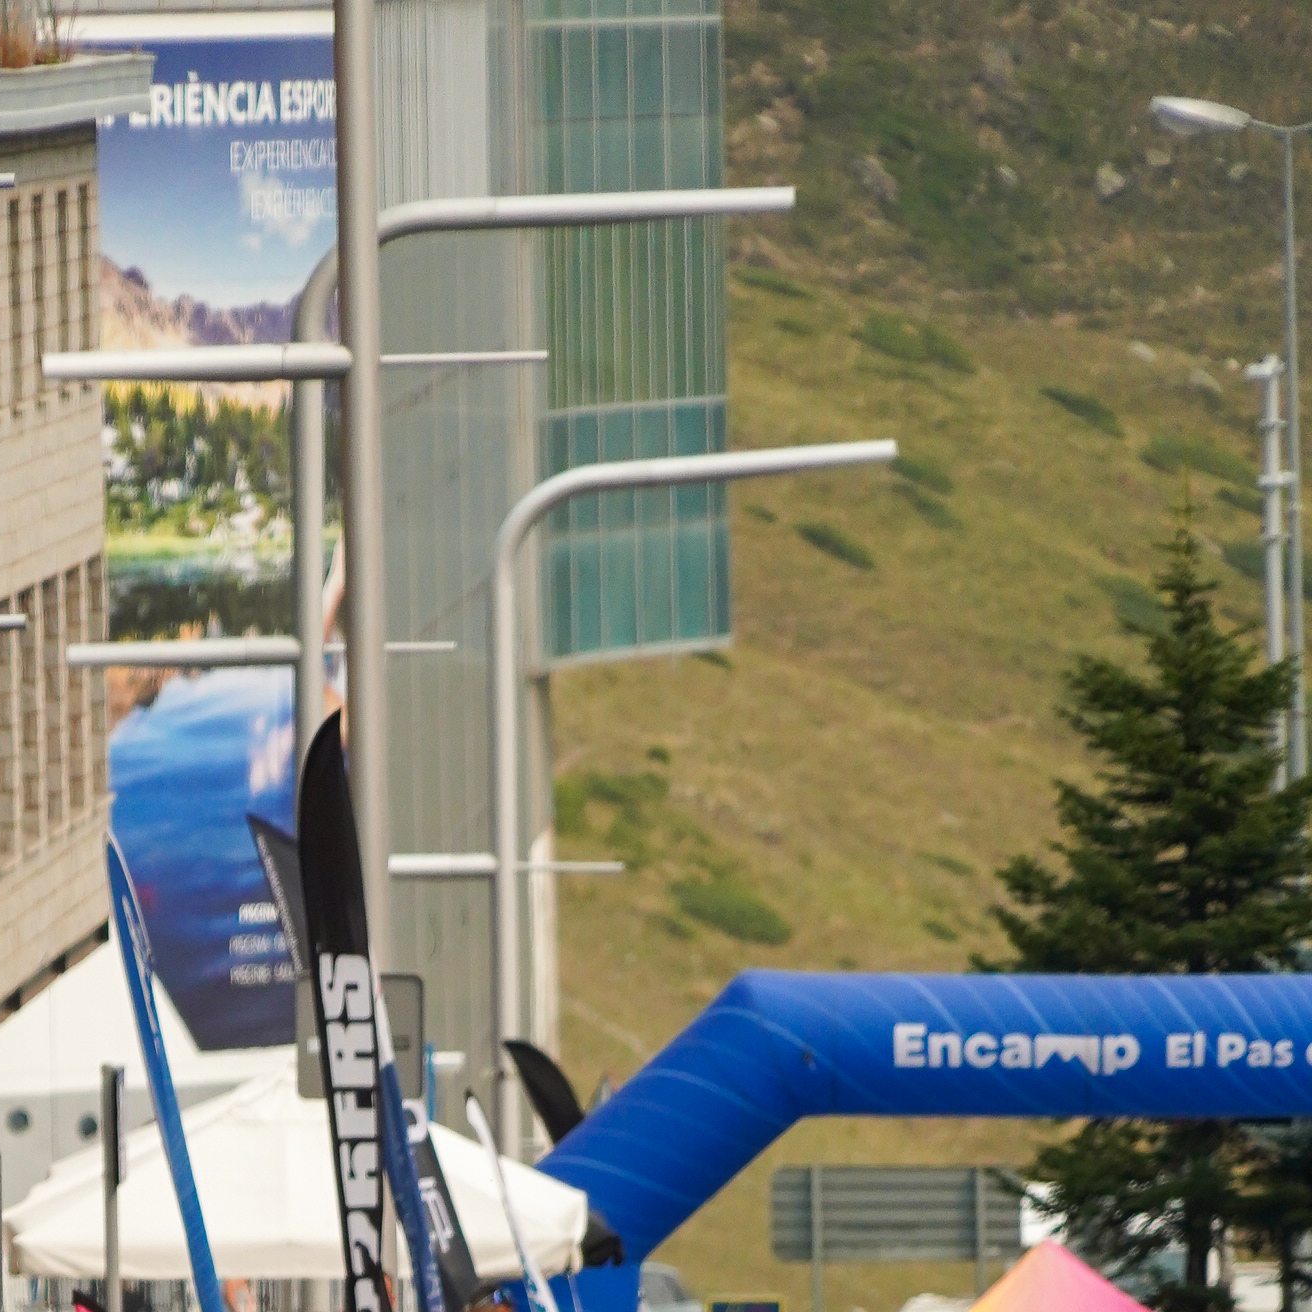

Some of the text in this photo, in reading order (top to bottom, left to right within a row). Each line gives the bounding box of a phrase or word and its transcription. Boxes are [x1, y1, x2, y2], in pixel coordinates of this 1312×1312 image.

[893, 1022, 1294, 1076] Encamp El Pas
